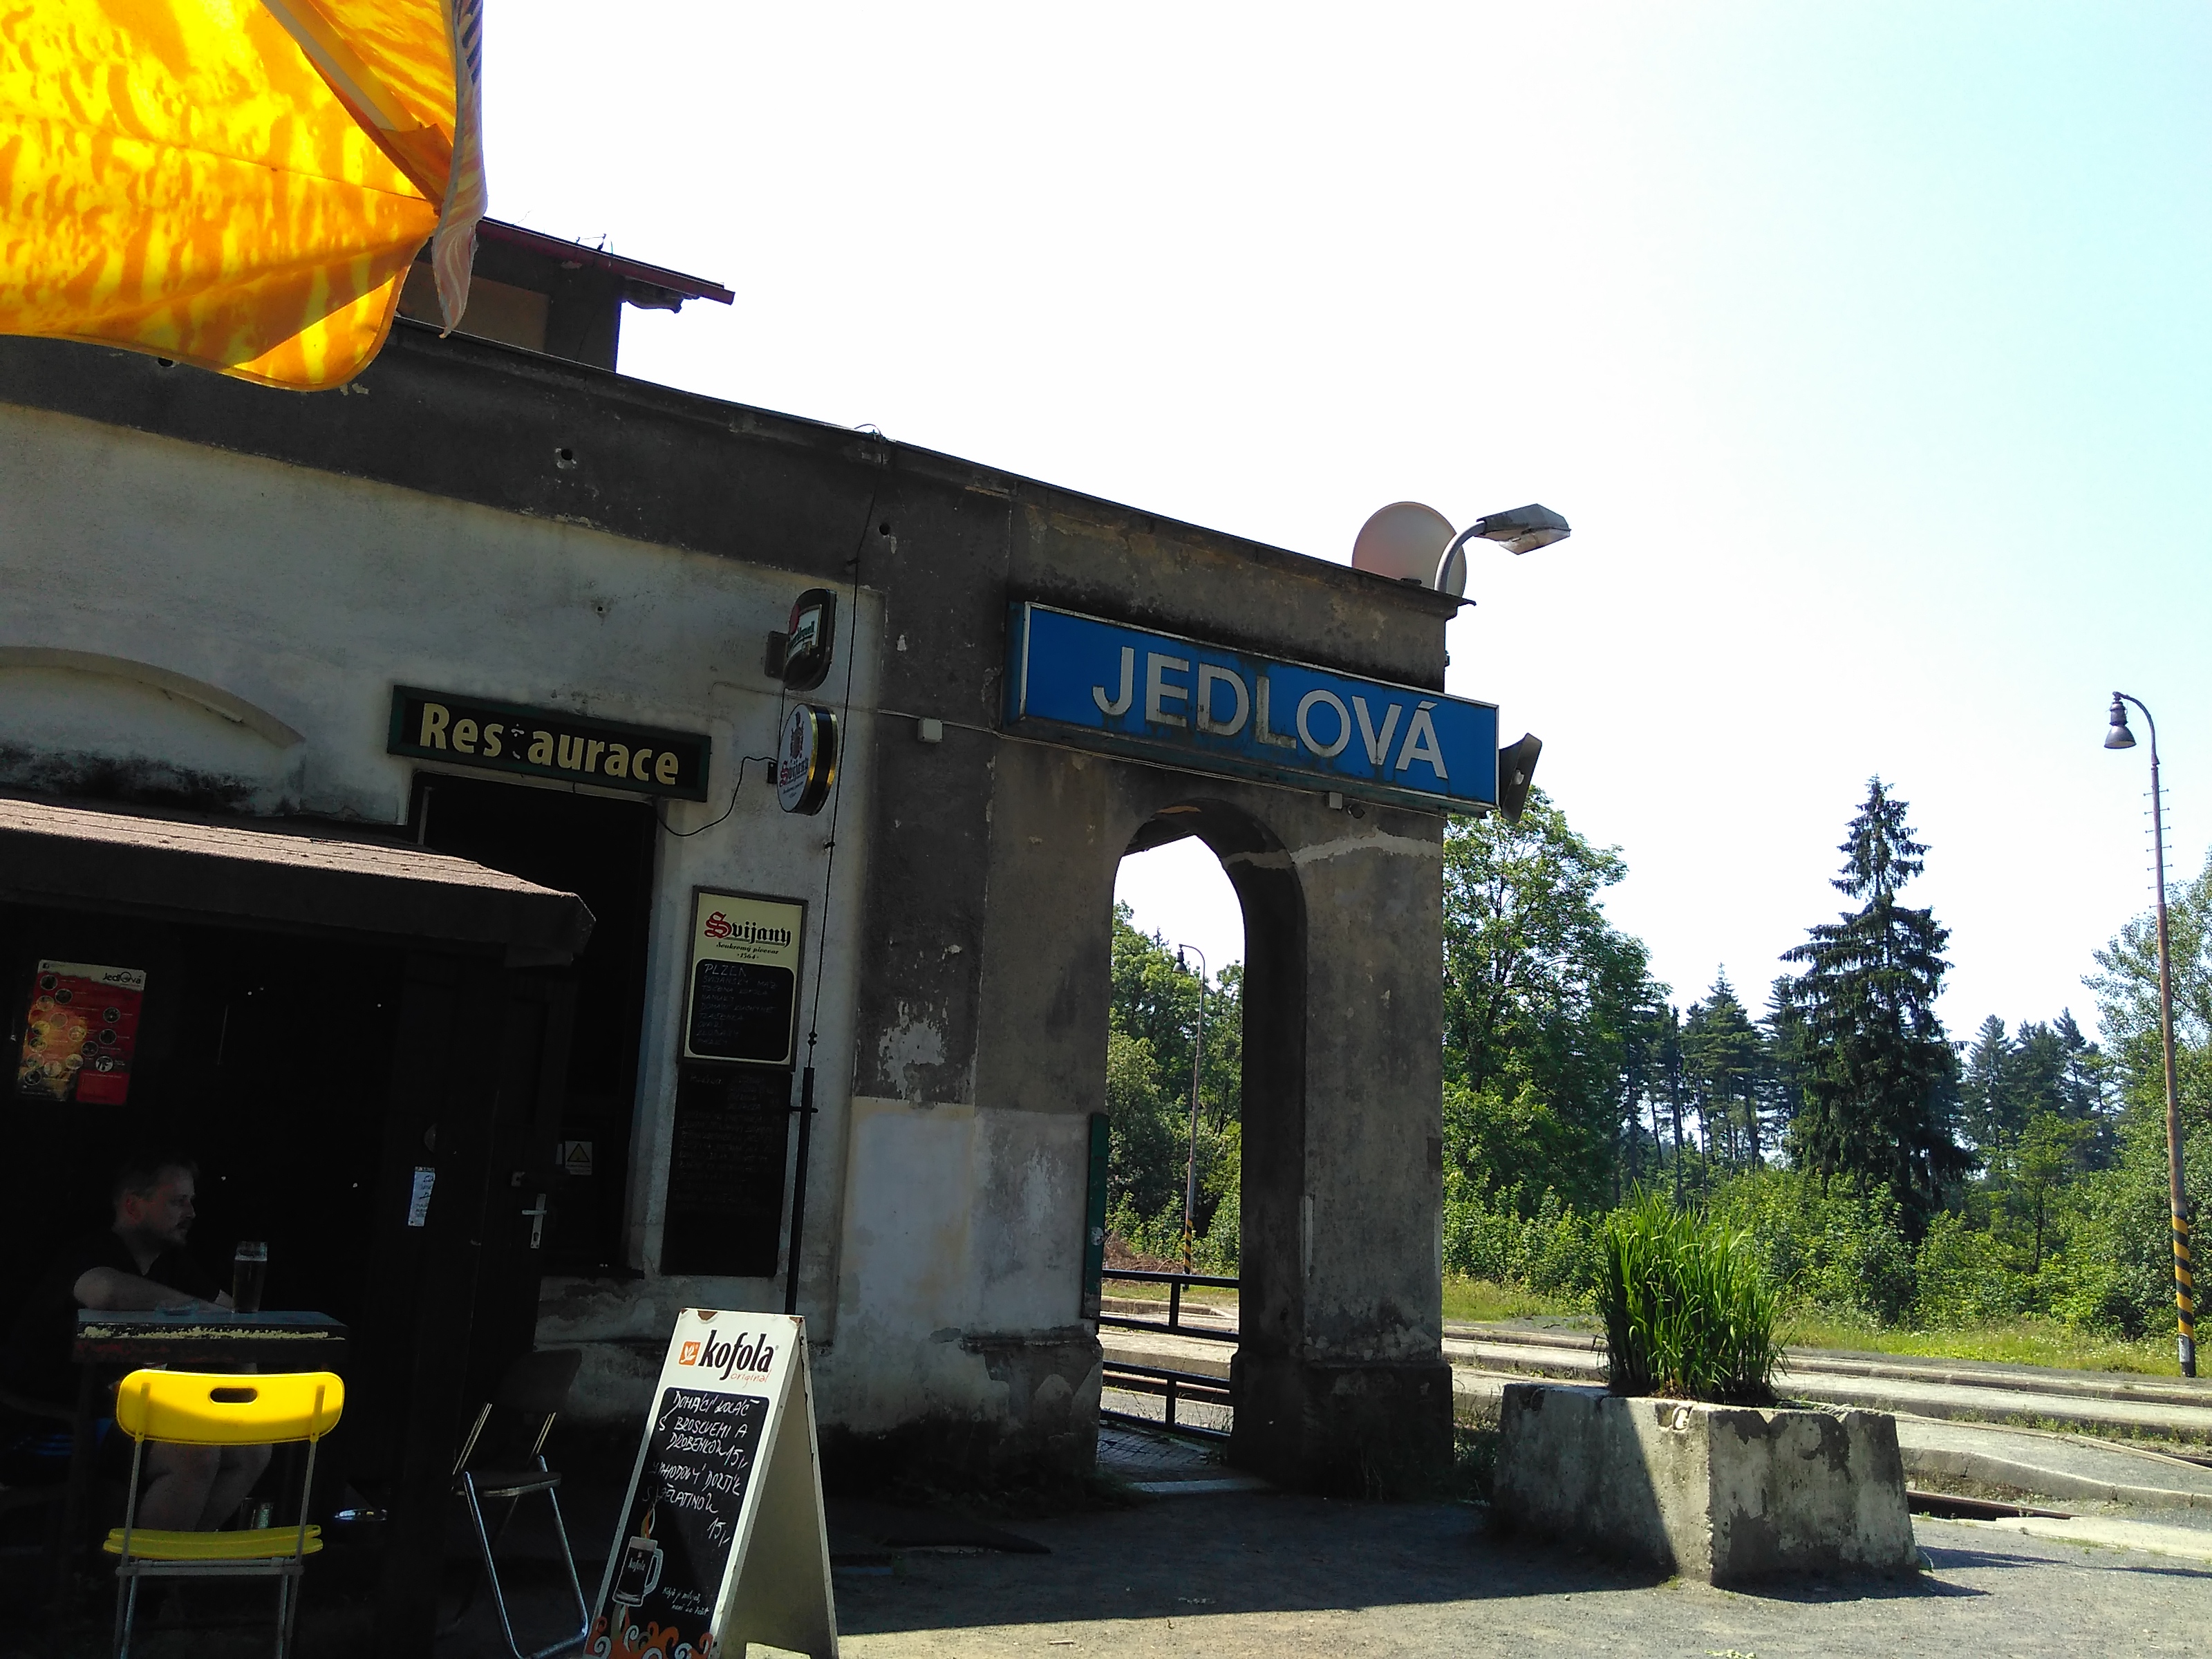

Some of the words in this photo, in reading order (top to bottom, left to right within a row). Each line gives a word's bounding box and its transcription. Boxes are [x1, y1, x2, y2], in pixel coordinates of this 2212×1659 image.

[1093, 646, 1448, 780] JEDLOVÁ
[419, 702, 680, 786] Resaurace
[704, 911, 791, 947] Svijany
[698, 1329, 774, 1380] kofola
[730, 1369, 772, 1389] original
[658, 1415, 667, 1432] S
[734, 1423, 749, 1438] A
